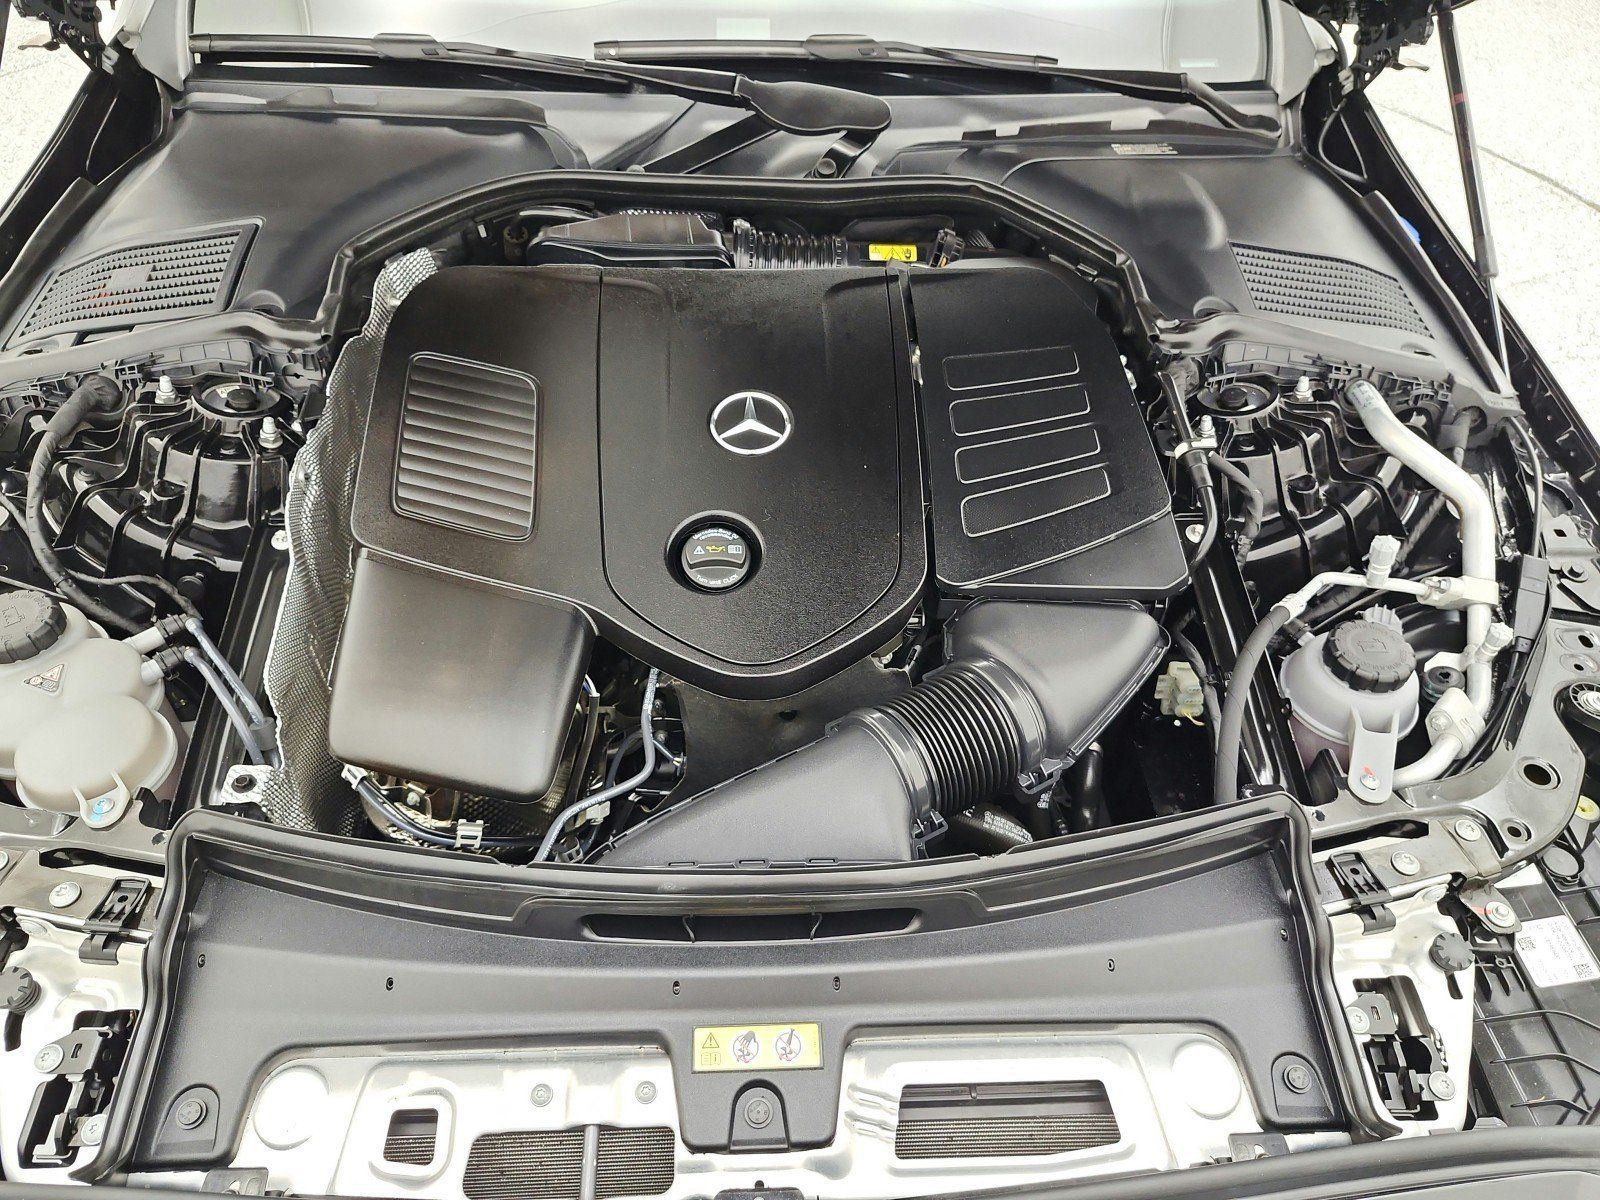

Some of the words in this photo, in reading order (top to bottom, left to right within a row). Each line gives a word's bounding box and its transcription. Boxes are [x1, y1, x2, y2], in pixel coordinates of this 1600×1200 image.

[692, 528, 732, 539] Mercedes-Benz
[696, 574, 708, 584] Turn
[723, 574, 739, 584] CLICK
